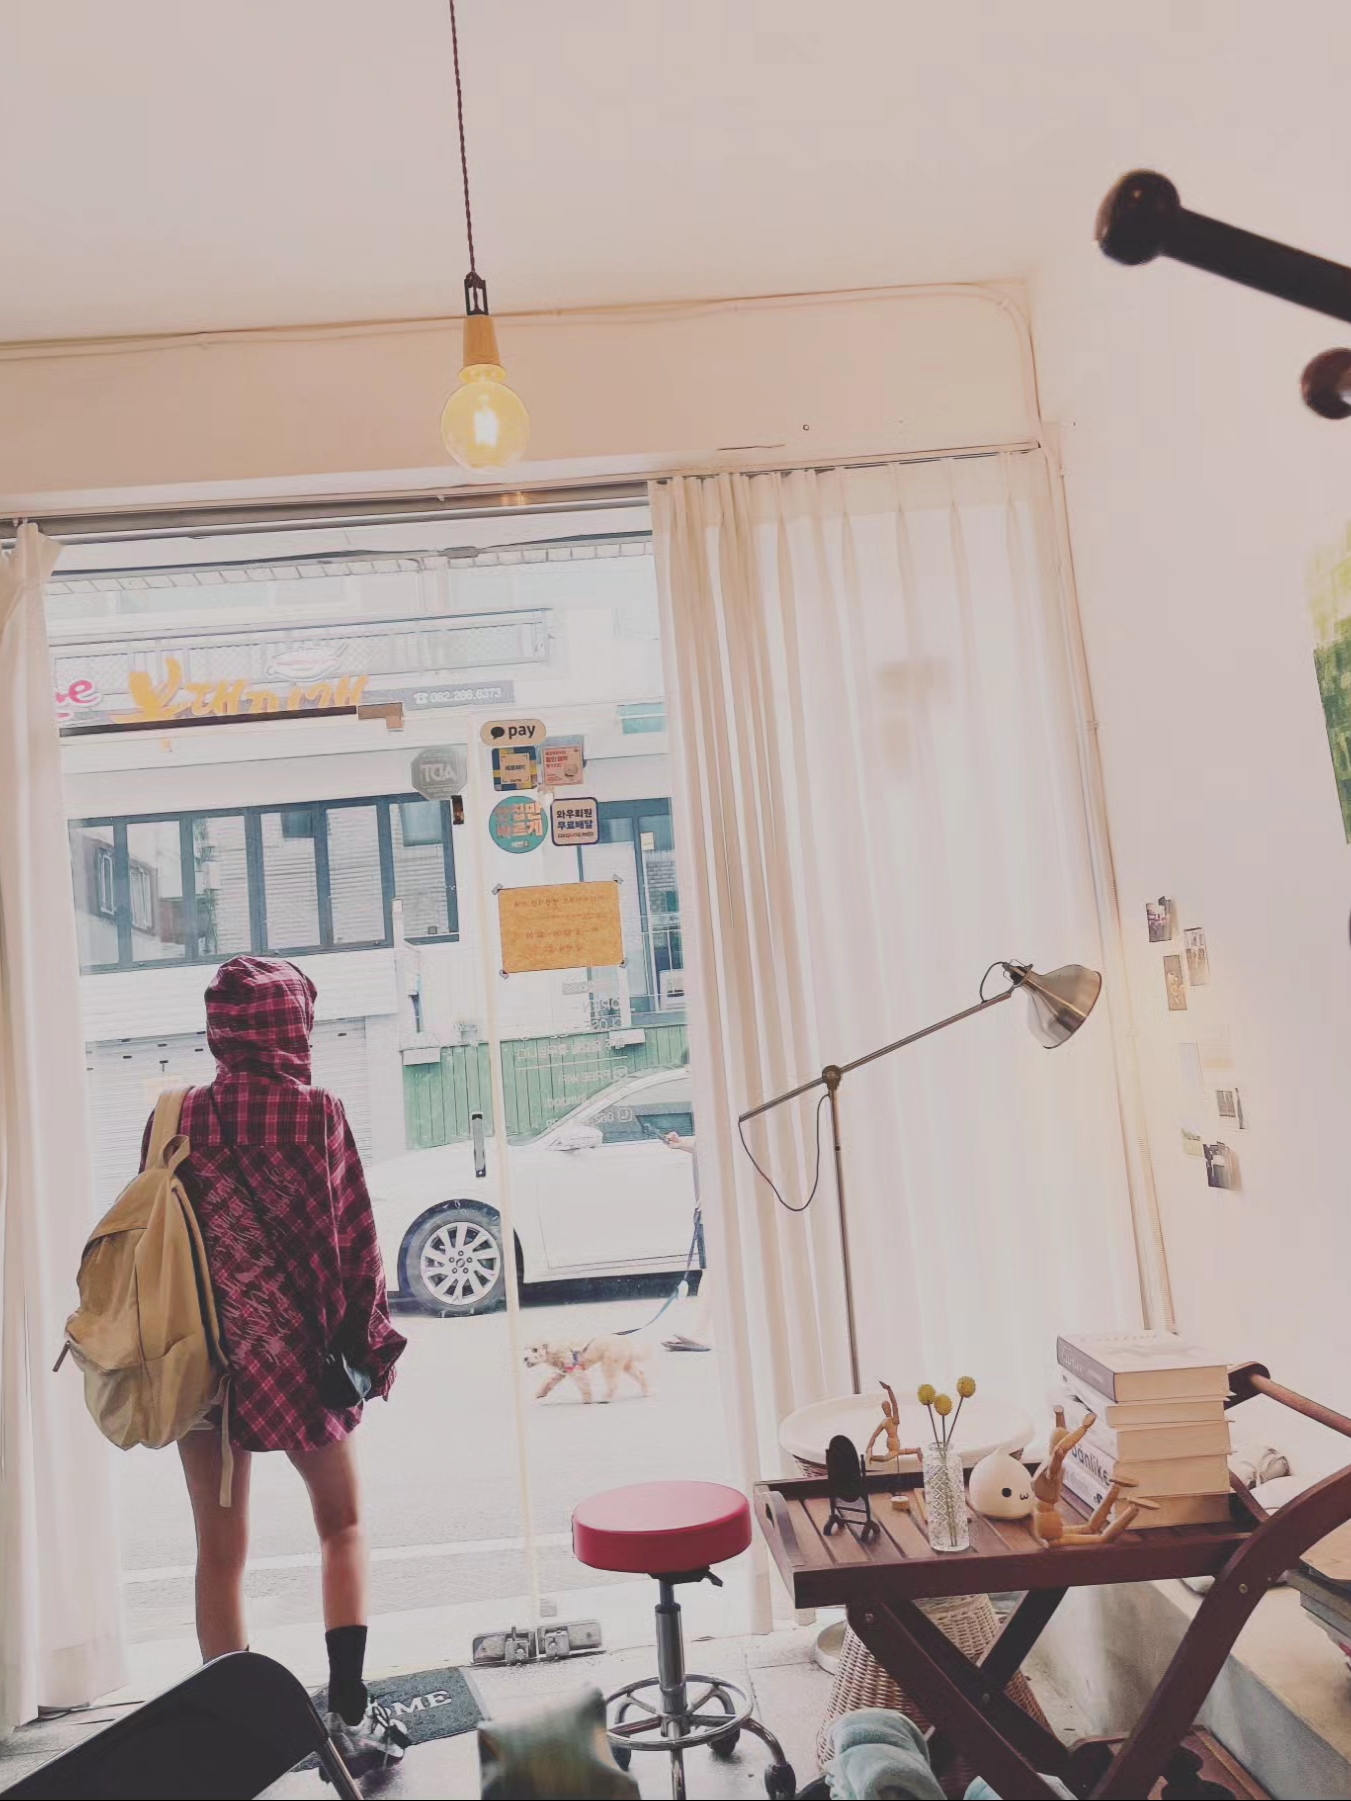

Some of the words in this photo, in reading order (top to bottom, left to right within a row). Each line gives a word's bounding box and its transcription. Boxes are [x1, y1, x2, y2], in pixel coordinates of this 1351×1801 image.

[508, 723, 536, 739] pay
[556, 808, 593, 819] 와우회원
[557, 820, 593, 830] 무료배달
